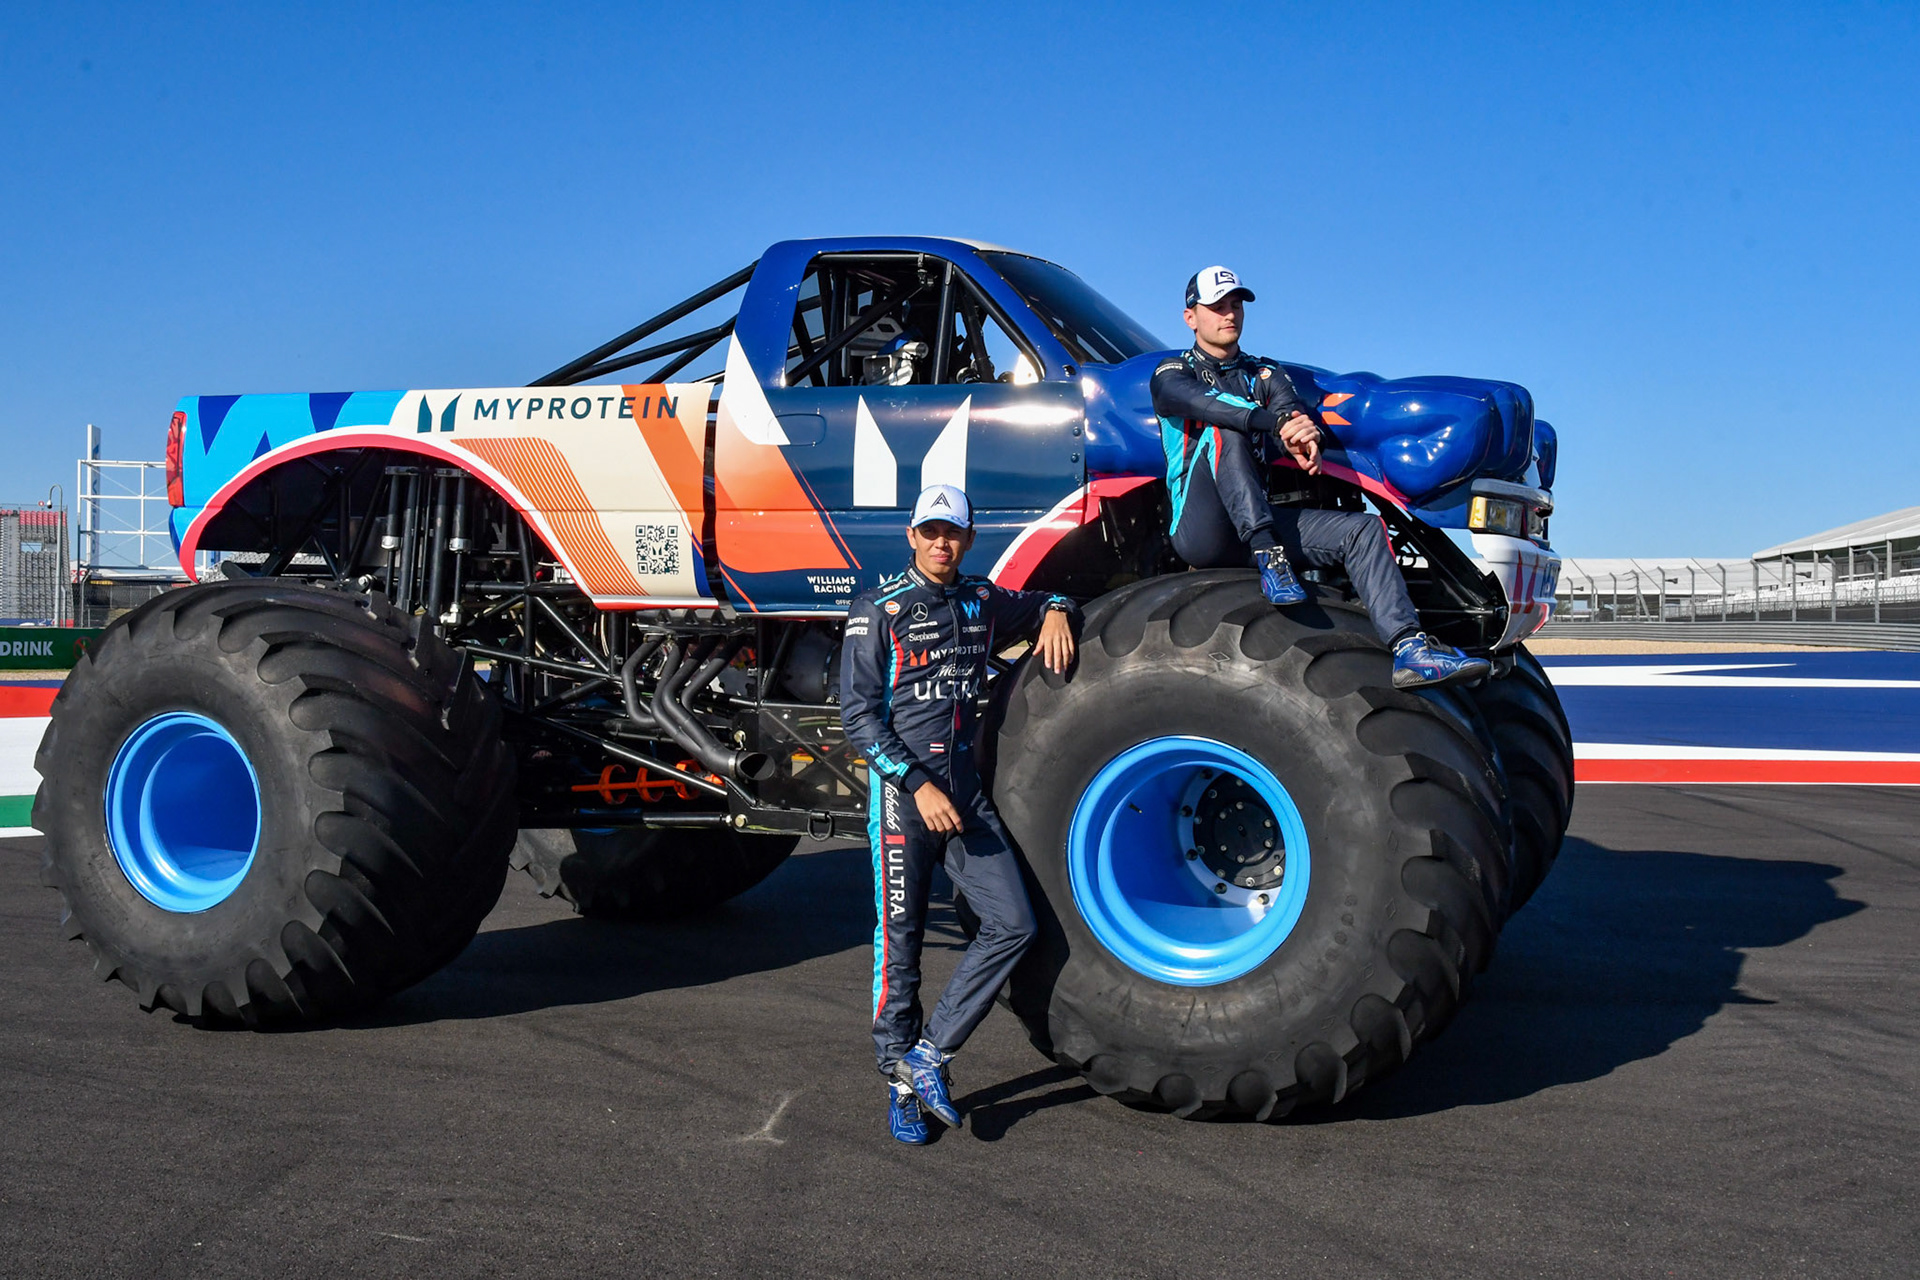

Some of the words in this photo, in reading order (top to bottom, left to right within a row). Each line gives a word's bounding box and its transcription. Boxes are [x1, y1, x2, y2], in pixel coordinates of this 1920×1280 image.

[473, 396, 679, 421] MYPROTEIN
[807, 576, 856, 585] WILLIAMS
[813, 585, 852, 594] RACING
[908, 631, 940, 642] Stephens
[0, 641, 54, 656] DRINK
[888, 849, 906, 919] ULTRA
